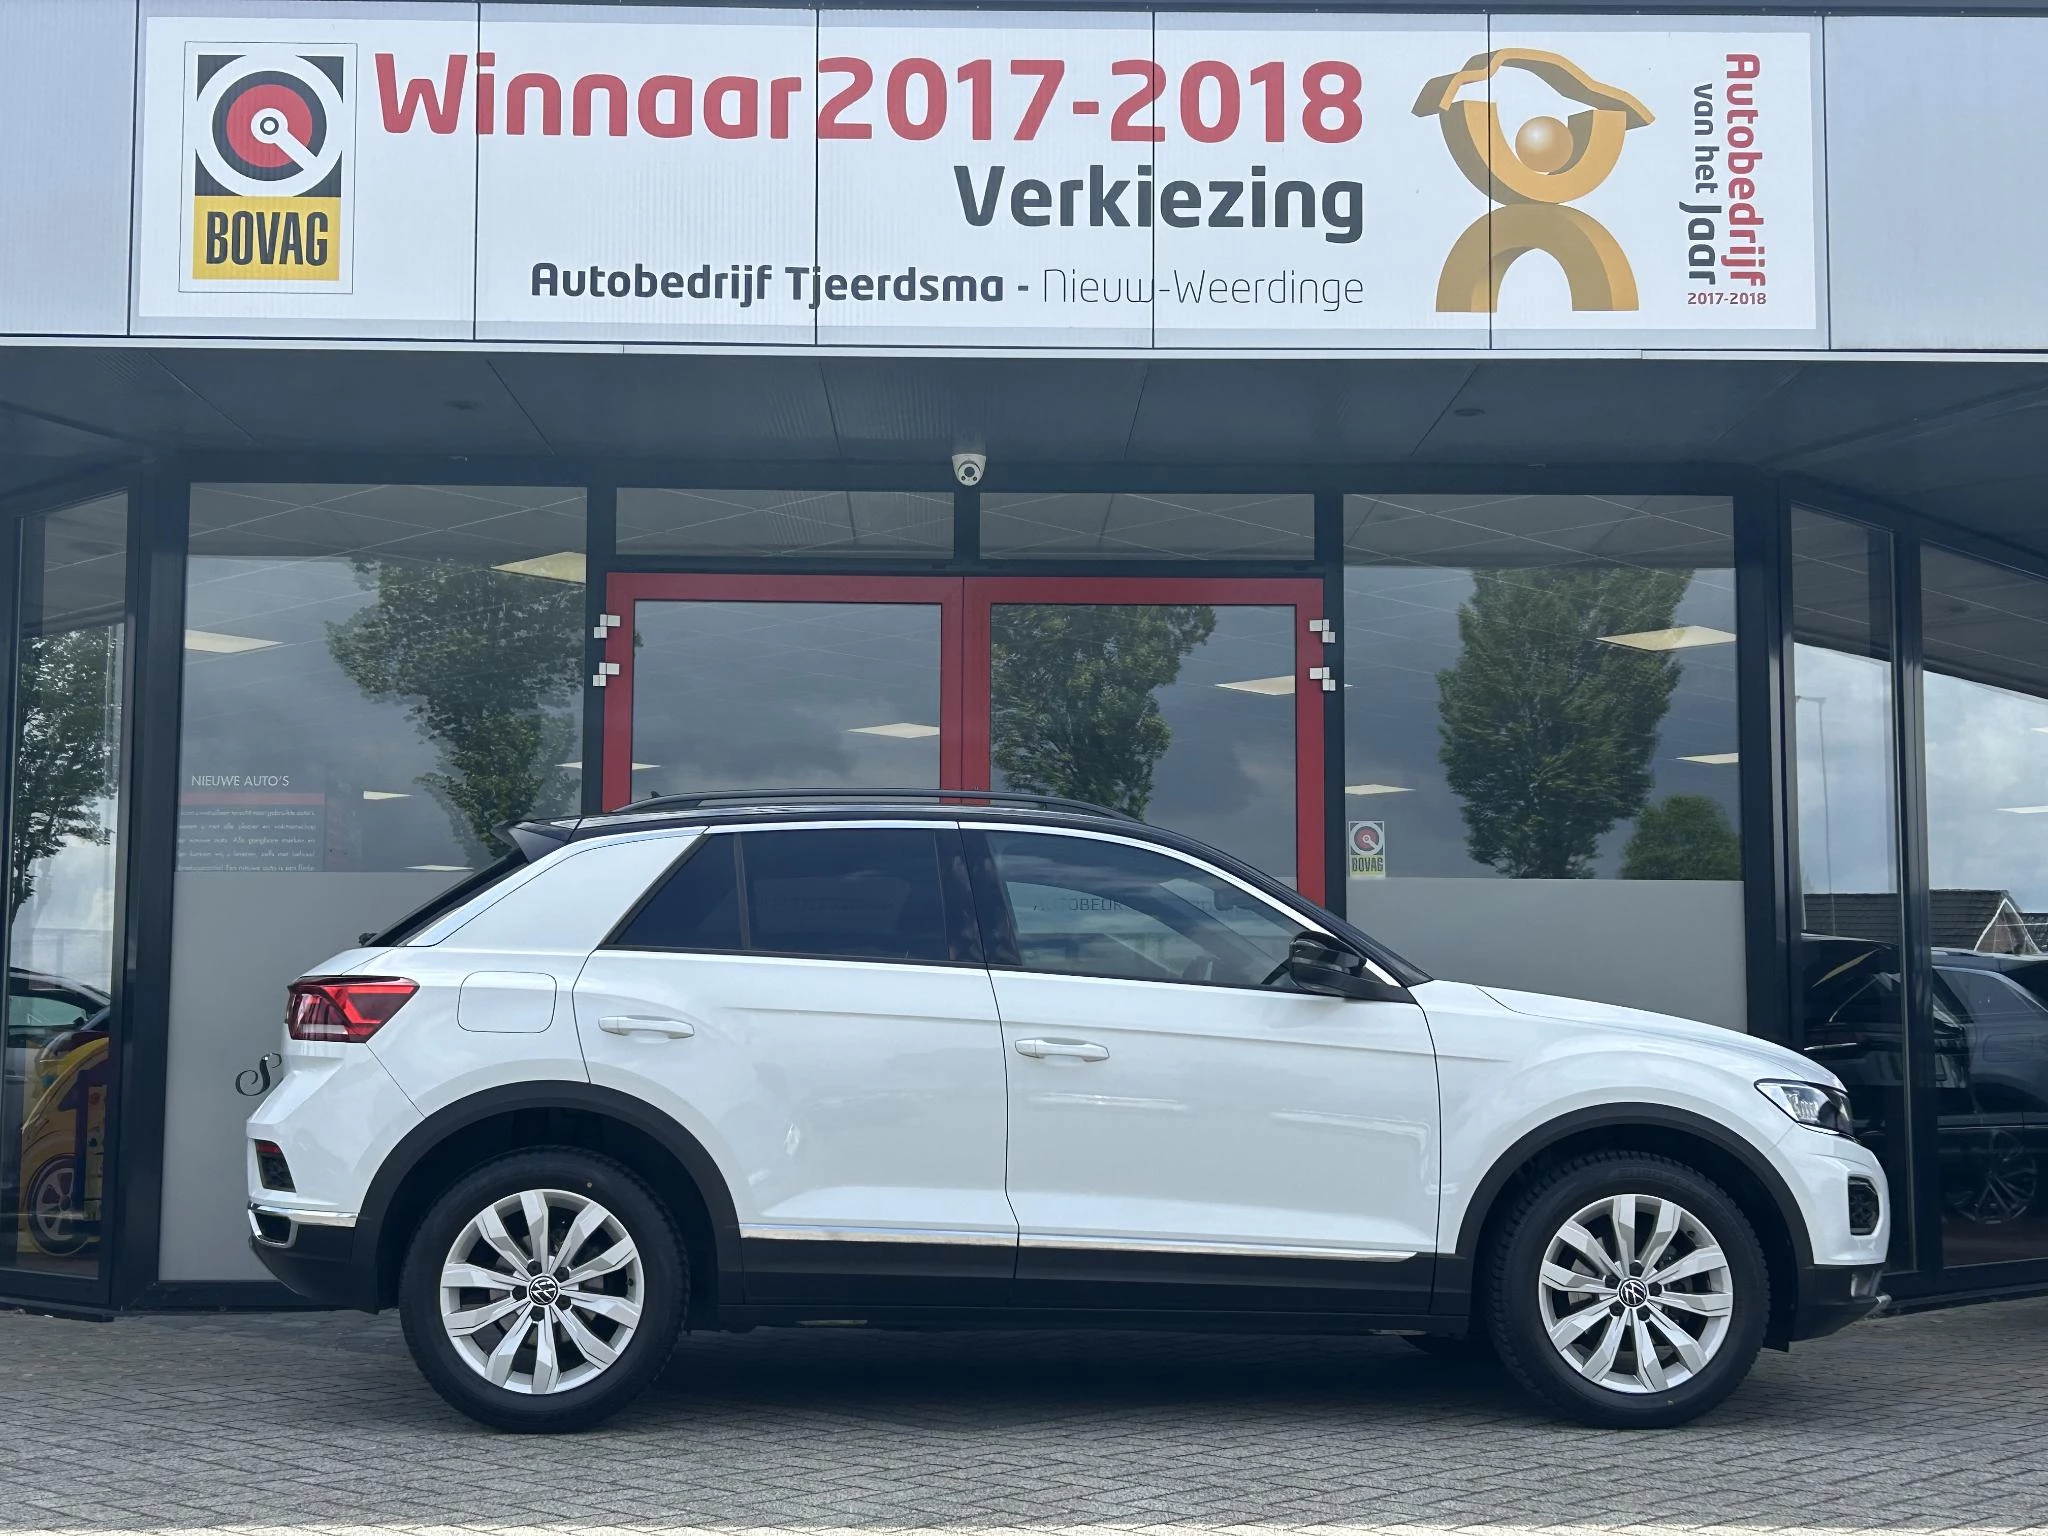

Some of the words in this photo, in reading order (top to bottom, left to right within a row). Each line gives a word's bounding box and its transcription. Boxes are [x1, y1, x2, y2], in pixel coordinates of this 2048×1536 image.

[375, 52, 802, 140] Winnaar
[818, 56, 1363, 144] 2017-2018
[1693, 82, 1714, 136] van
[1694, 145, 1721, 194] het
[1717, 53, 1766, 287] Autobedrijf
[953, 164, 1364, 245] Verkiezing
[206, 210, 328, 267] BOVAG
[1678, 201, 1722, 286] Jaar
[531, 262, 773, 308] Autobedrijf
[784, 266, 1004, 311] Tjeerdsma
[1043, 268, 1364, 312] Nieuw-Weerdinge
[1687, 292, 1767, 305] 2017-2018
[191, 775, 241, 787] NIEUWE
[244, 775, 290, 787] AUTO'S
[1351, 856, 1384, 872] BOVAG
